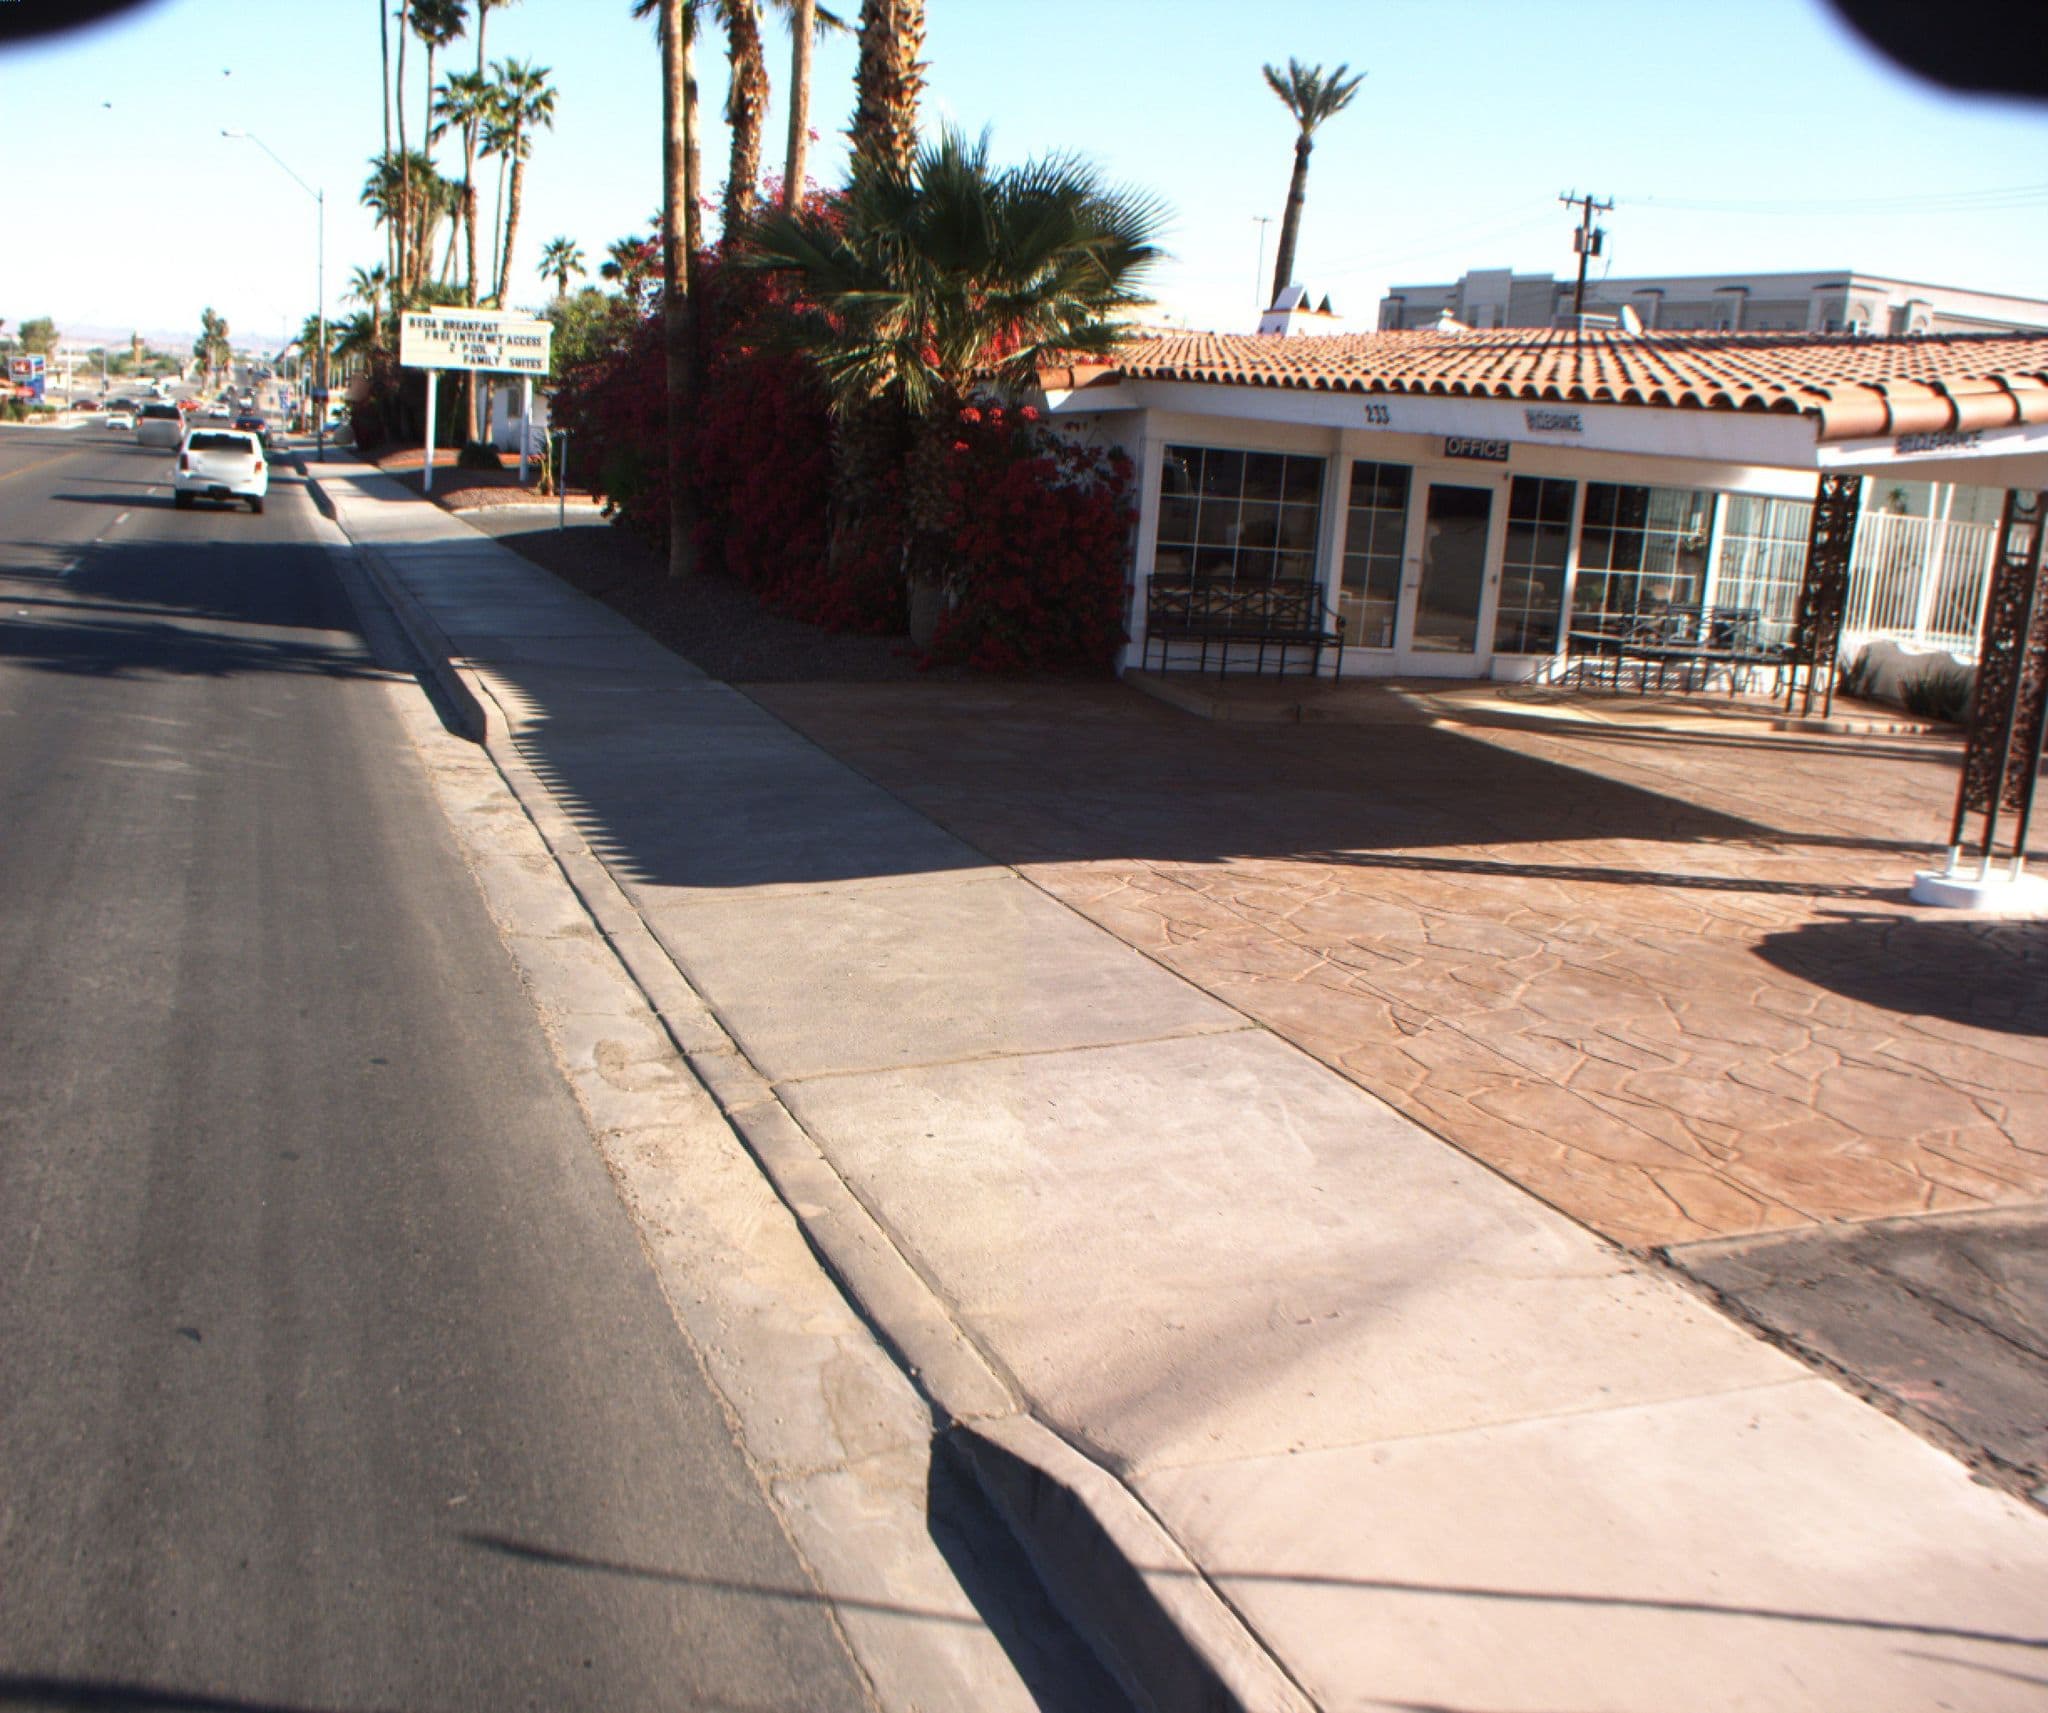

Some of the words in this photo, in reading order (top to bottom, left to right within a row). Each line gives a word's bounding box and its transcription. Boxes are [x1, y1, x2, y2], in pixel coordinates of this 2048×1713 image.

[443, 321, 498, 332] BREAKFAST
[506, 335, 542, 346] ACCESS
[464, 356, 500, 367] FAMILY
[509, 358, 542, 369] SUITES
[1448, 438, 1507, 458] OFFICE
